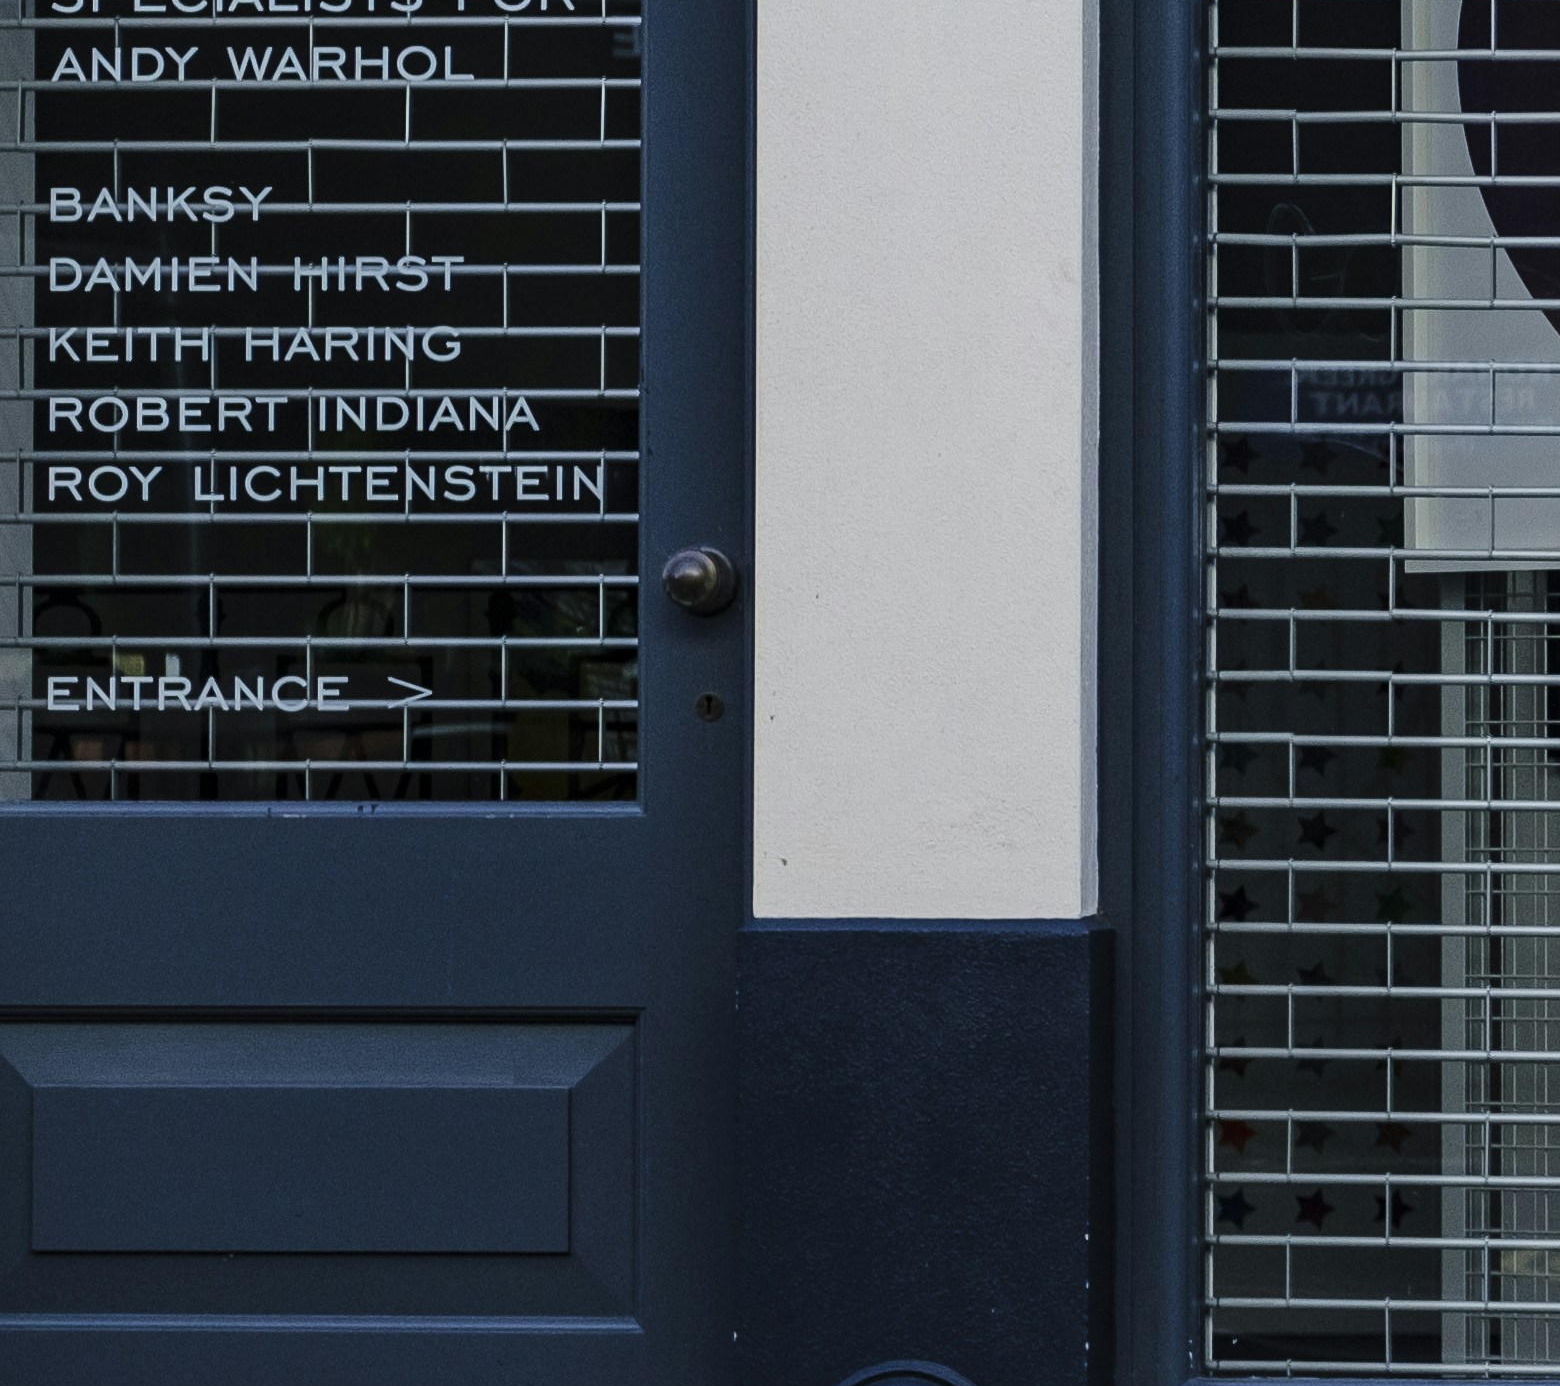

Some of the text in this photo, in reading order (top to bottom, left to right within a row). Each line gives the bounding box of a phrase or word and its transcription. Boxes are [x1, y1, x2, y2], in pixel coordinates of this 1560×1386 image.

[52, 45, 475, 82] ANDY WARHOL
[49, 186, 273, 223] BANKSY
[49, 256, 464, 292] DAMIEN HIRST
[48, 327, 461, 362] KEITH HARING
[48, 396, 540, 432] ROBERT INDIANA
[48, 466, 603, 502] ROY LICHTENSTEIN
[47, 676, 349, 712] ENTRANCE
